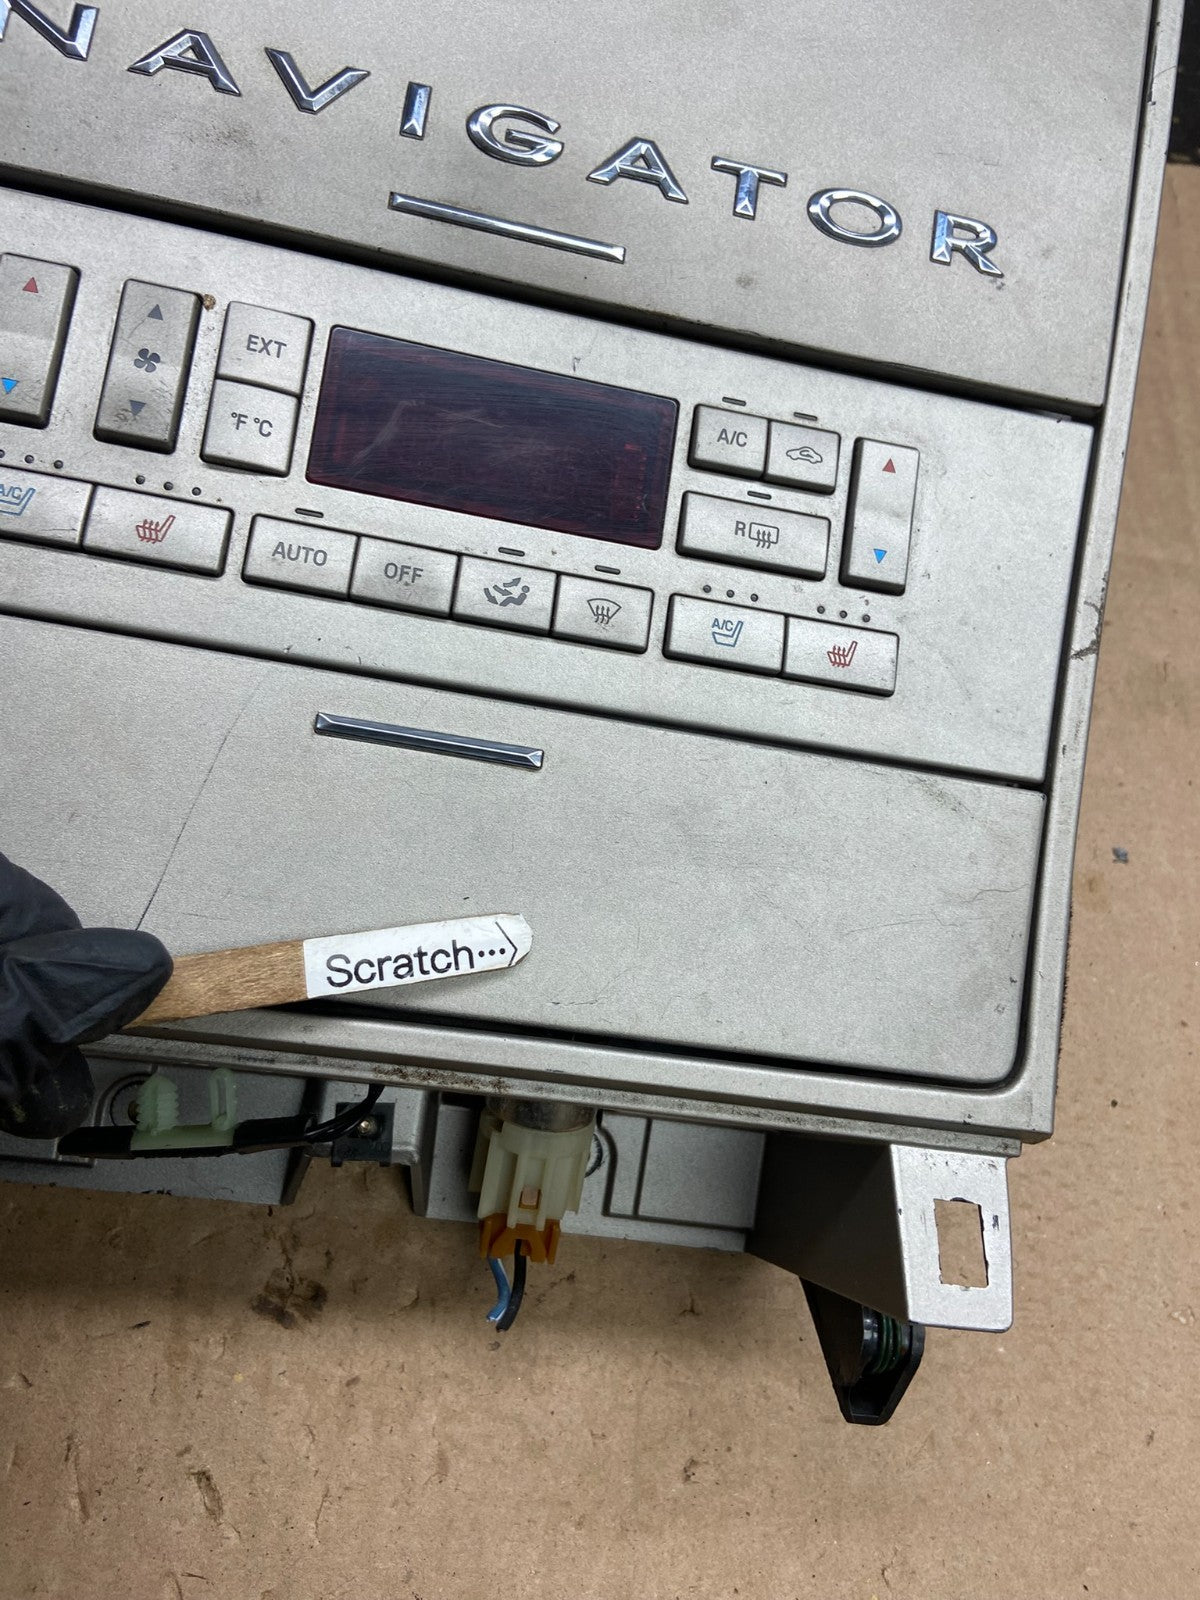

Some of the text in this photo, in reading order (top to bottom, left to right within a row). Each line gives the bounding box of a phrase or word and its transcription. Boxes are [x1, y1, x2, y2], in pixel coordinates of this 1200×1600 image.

[0, 0, 1004, 278] NAVIGATOR
[246, 334, 287, 358] EXT
[716, 428, 748, 447] A/C
[734, 520, 746, 537] R
[271, 541, 328, 567] AUTO
[383, 562, 424, 584] OFF
[711, 617, 734, 632] A/C
